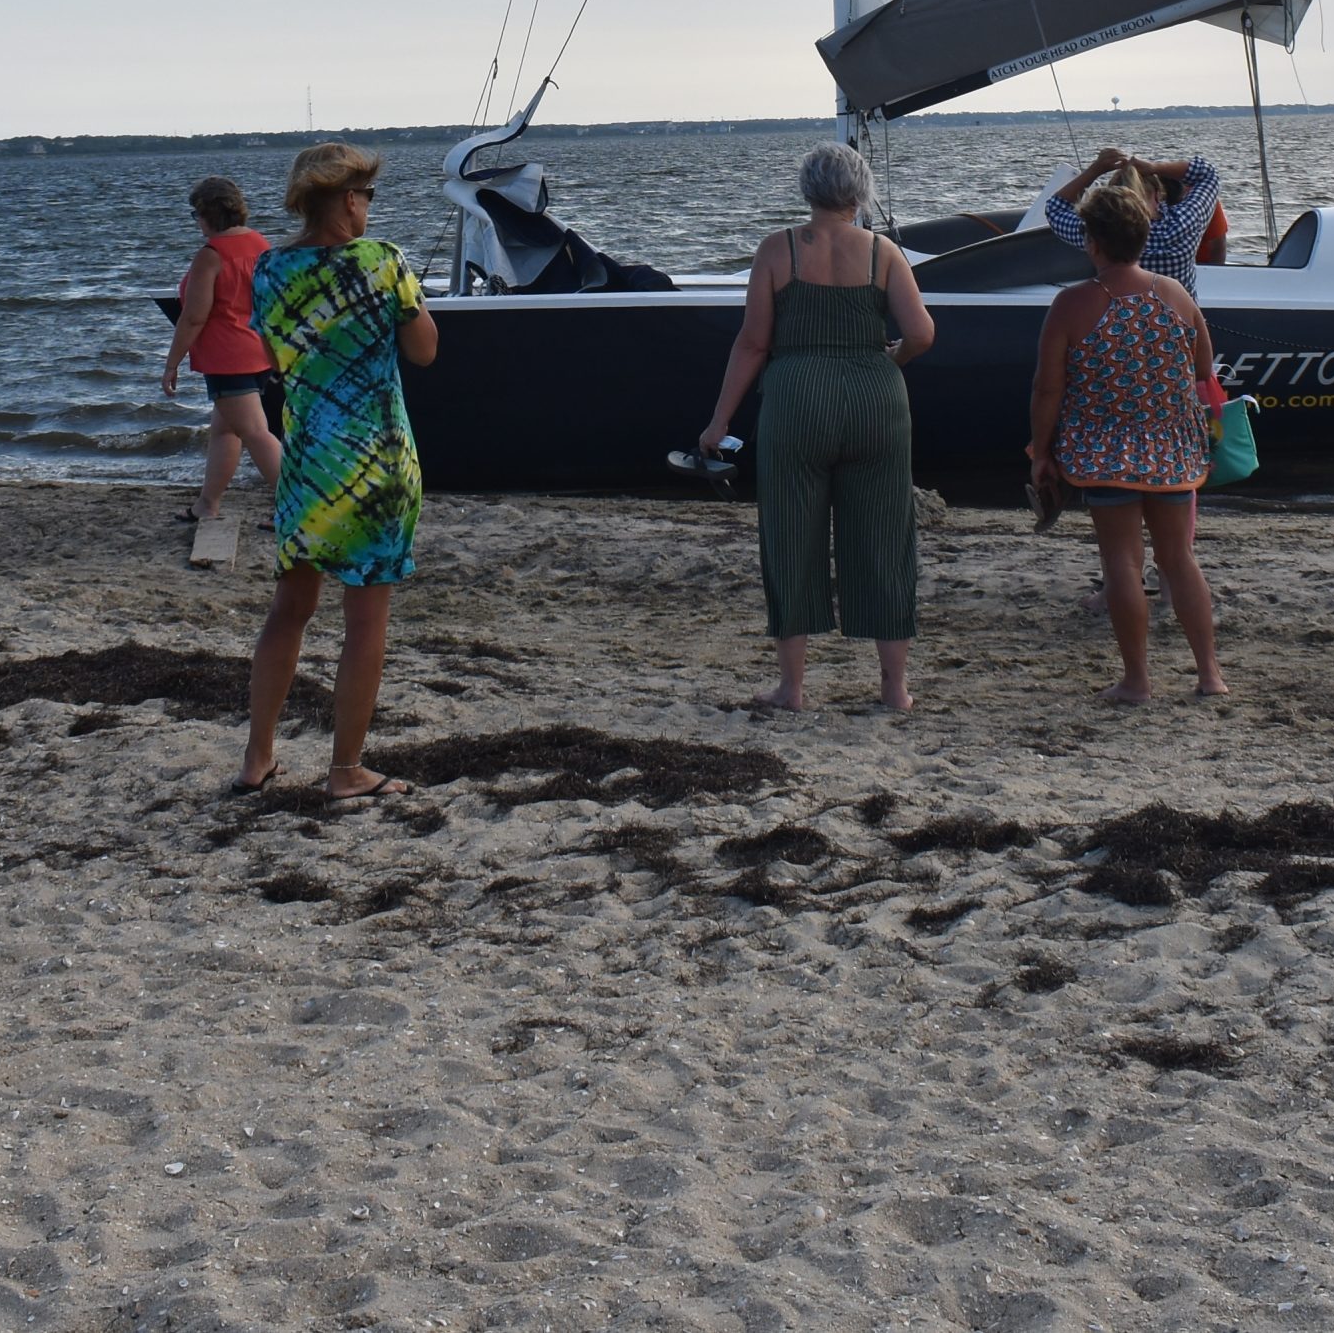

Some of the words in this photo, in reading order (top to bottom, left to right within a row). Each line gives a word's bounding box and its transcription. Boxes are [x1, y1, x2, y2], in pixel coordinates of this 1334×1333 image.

[1019, 52, 1049, 69] YOUR
[1050, 42, 1078, 58] HEAD
[1080, 35, 1098, 48] ON
[1098, 27, 1119, 41] THE
[1121, 15, 1156, 33] BOOM
